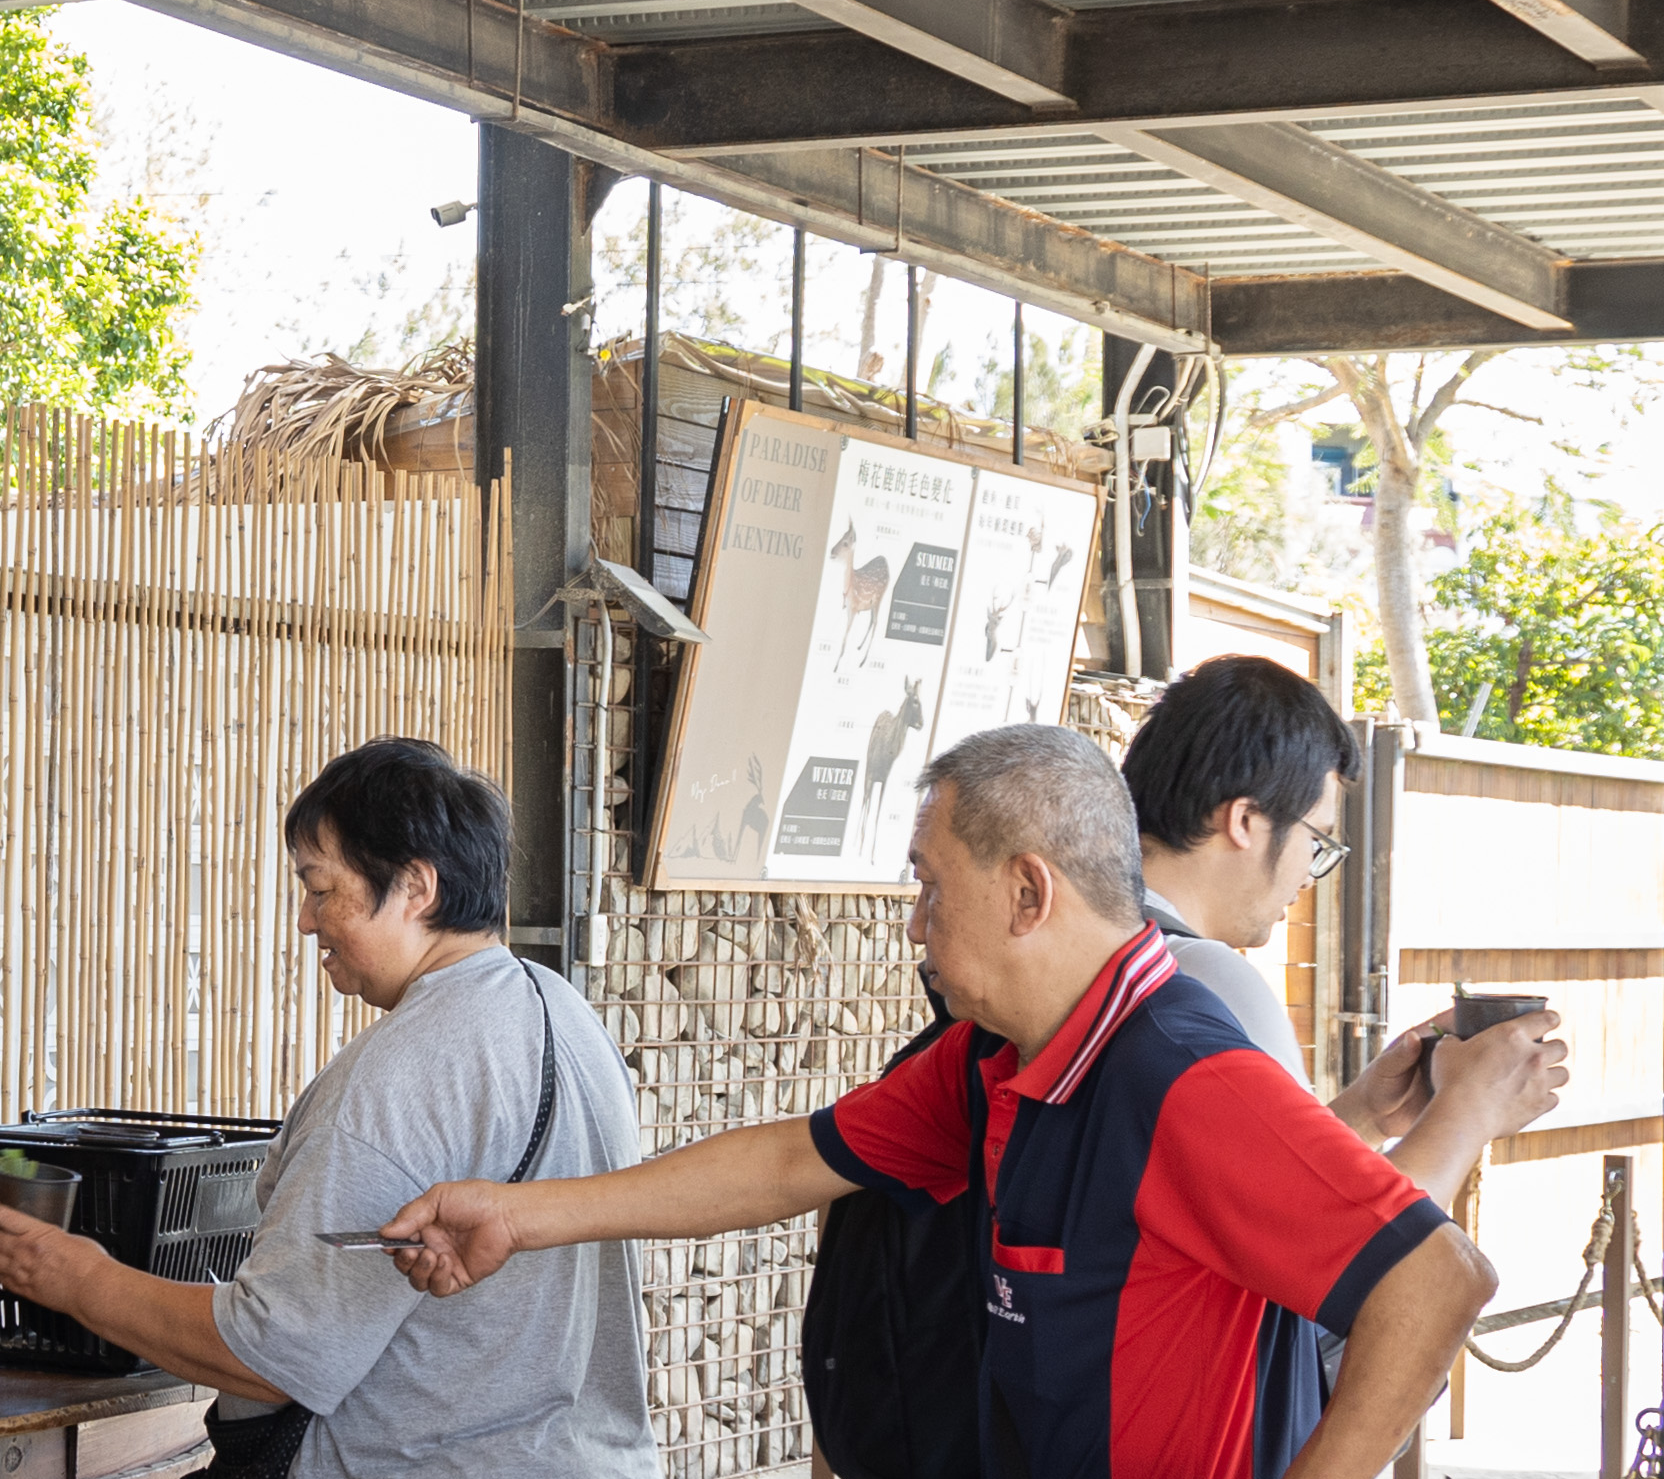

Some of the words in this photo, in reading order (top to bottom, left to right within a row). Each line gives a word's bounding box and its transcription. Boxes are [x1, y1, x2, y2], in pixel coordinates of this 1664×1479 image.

[748, 432, 829, 473] PARADISE
[740, 476, 762, 506] OF
[763, 482, 803, 513] DEER
[856, 458, 955, 505] 梅花鹿的毛色變化
[731, 523, 805, 560] KENTING
[915, 551, 955, 573] SUMMER
[811, 765, 855, 786] WINTER
